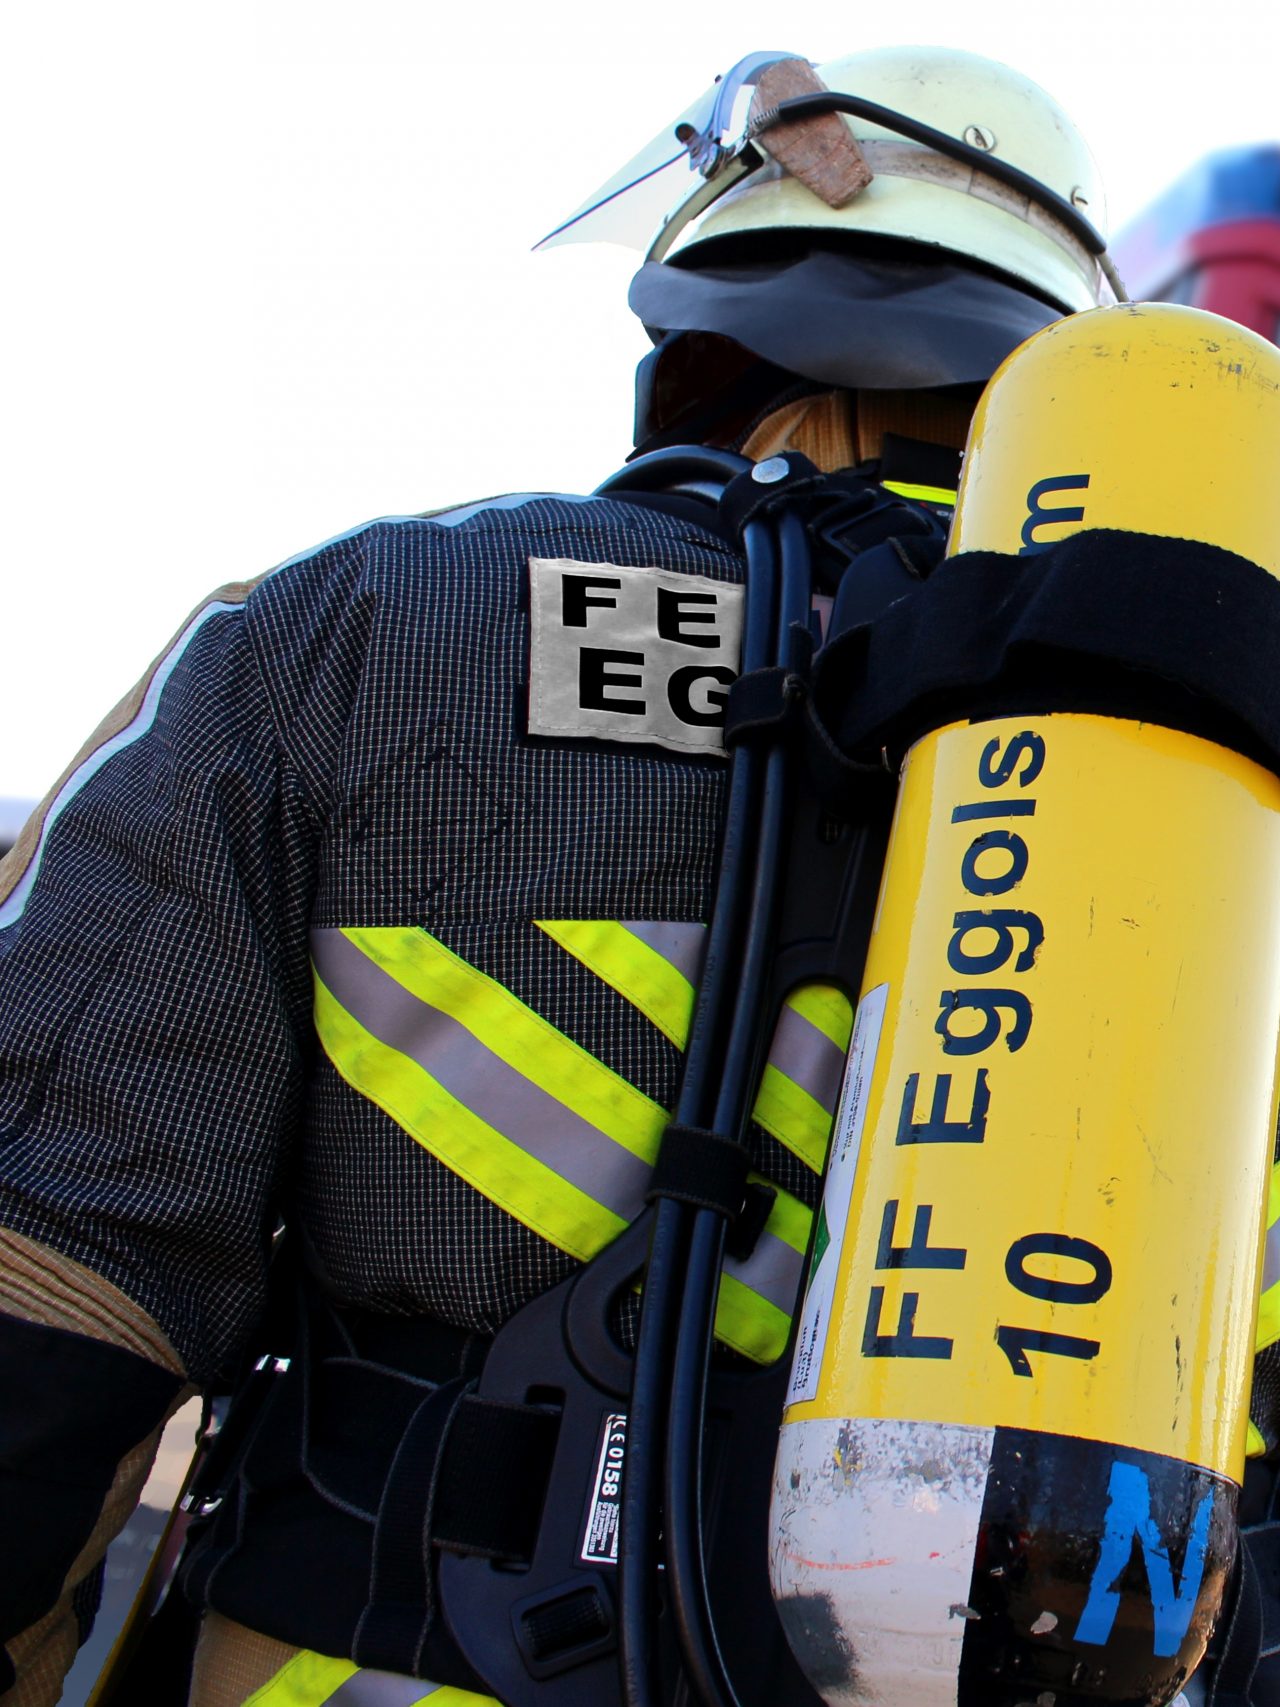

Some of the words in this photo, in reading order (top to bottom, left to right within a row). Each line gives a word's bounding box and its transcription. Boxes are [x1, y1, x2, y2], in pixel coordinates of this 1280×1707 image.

[579, 647, 739, 728] EG
[861, 1199, 967, 1359] FF
[995, 1233, 1112, 1378] 10
[602, 1448, 624, 1496] 0158
